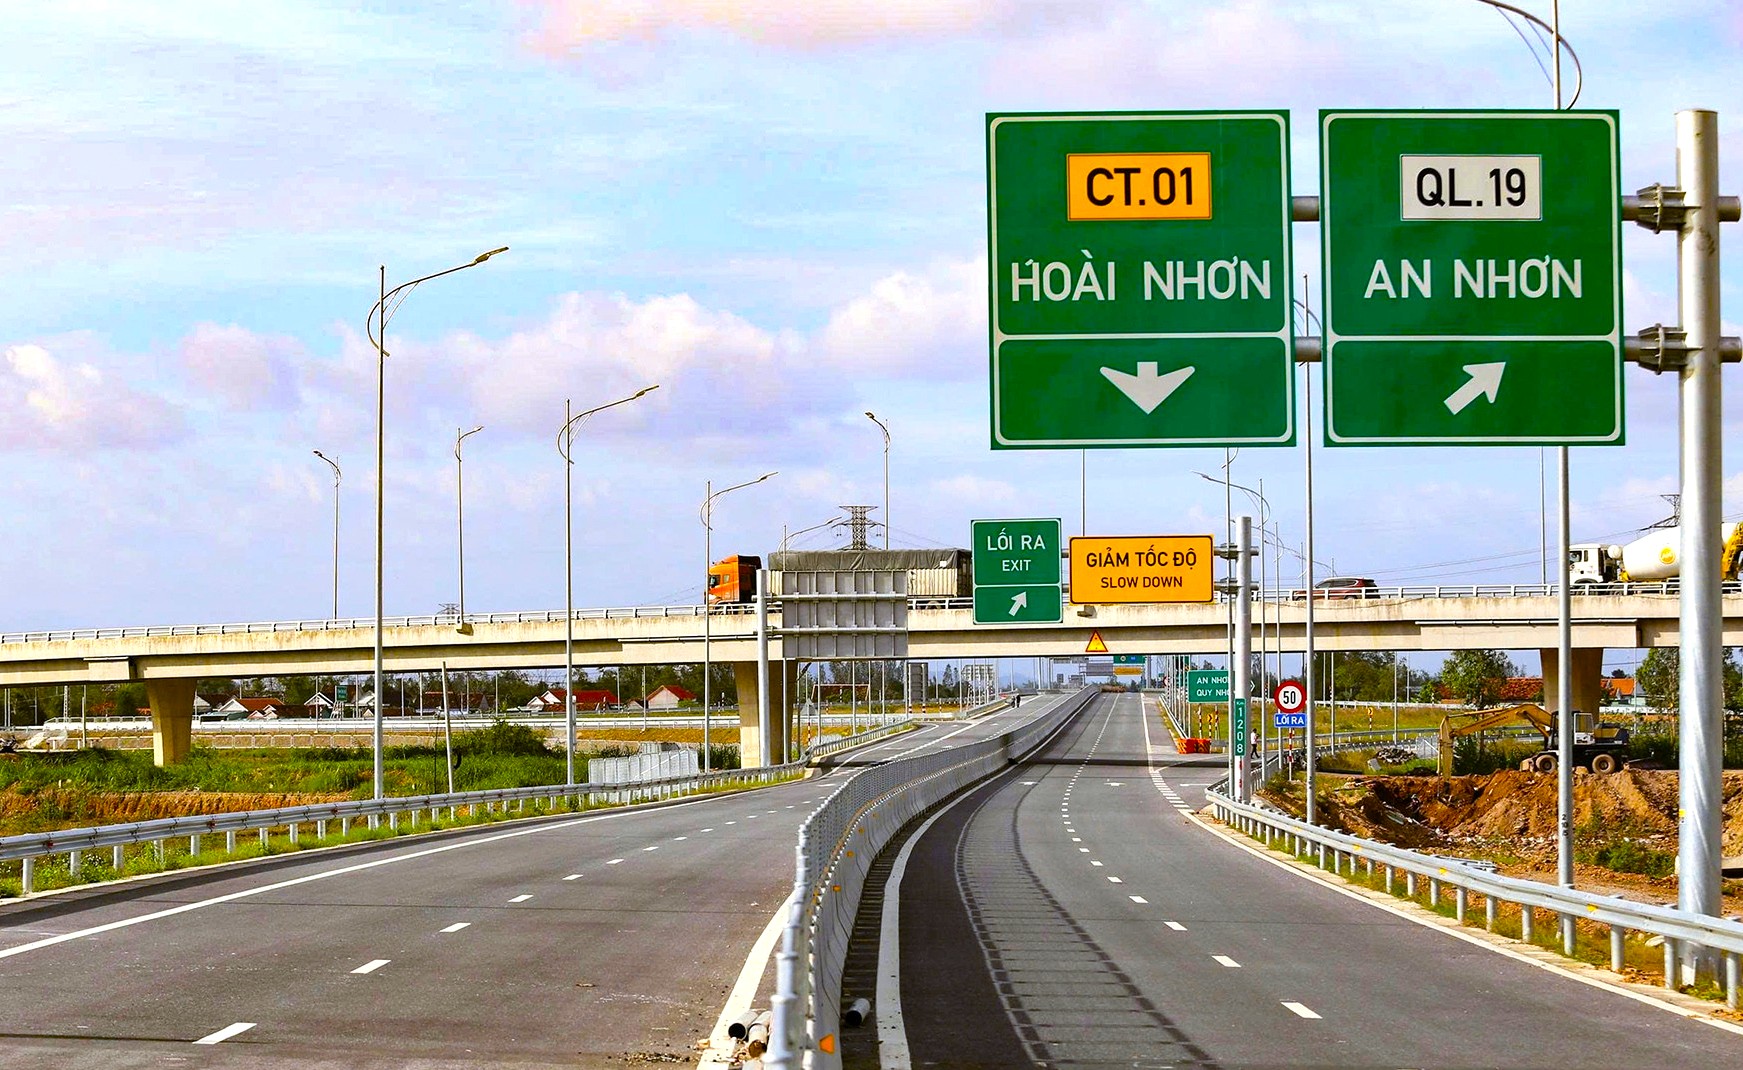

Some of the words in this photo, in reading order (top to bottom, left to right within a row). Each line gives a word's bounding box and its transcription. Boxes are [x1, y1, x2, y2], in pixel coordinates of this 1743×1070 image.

[1086, 167, 1193, 206] CT.01
[1416, 168, 1526, 207] QL.19
[1143, 256, 1271, 300] NHƠN
[1363, 259, 1432, 298] AN
[1454, 255, 1582, 298] NHƠN
[987, 528, 1013, 550] LỐI
[1021, 534, 1046, 550] RA
[1002, 559, 1032, 572] EXIT
[1086, 547, 1129, 568] GIẢM
[1135, 545, 1168, 567] TỐC
[1173, 548, 1197, 570] ĐỘ
[1100, 577, 1139, 588] SLOW
[1143, 576, 1183, 588] DOWN
[1196, 676, 1208, 684] AN
[1211, 675, 1229, 684] NHƠ
[1196, 689, 1212, 697] QUY
[1283, 691, 1296, 704] 50
[1236, 707, 1244, 753] 1208
[1276, 714, 1289, 725] LỐI
[1291, 716, 1304, 725] RA
